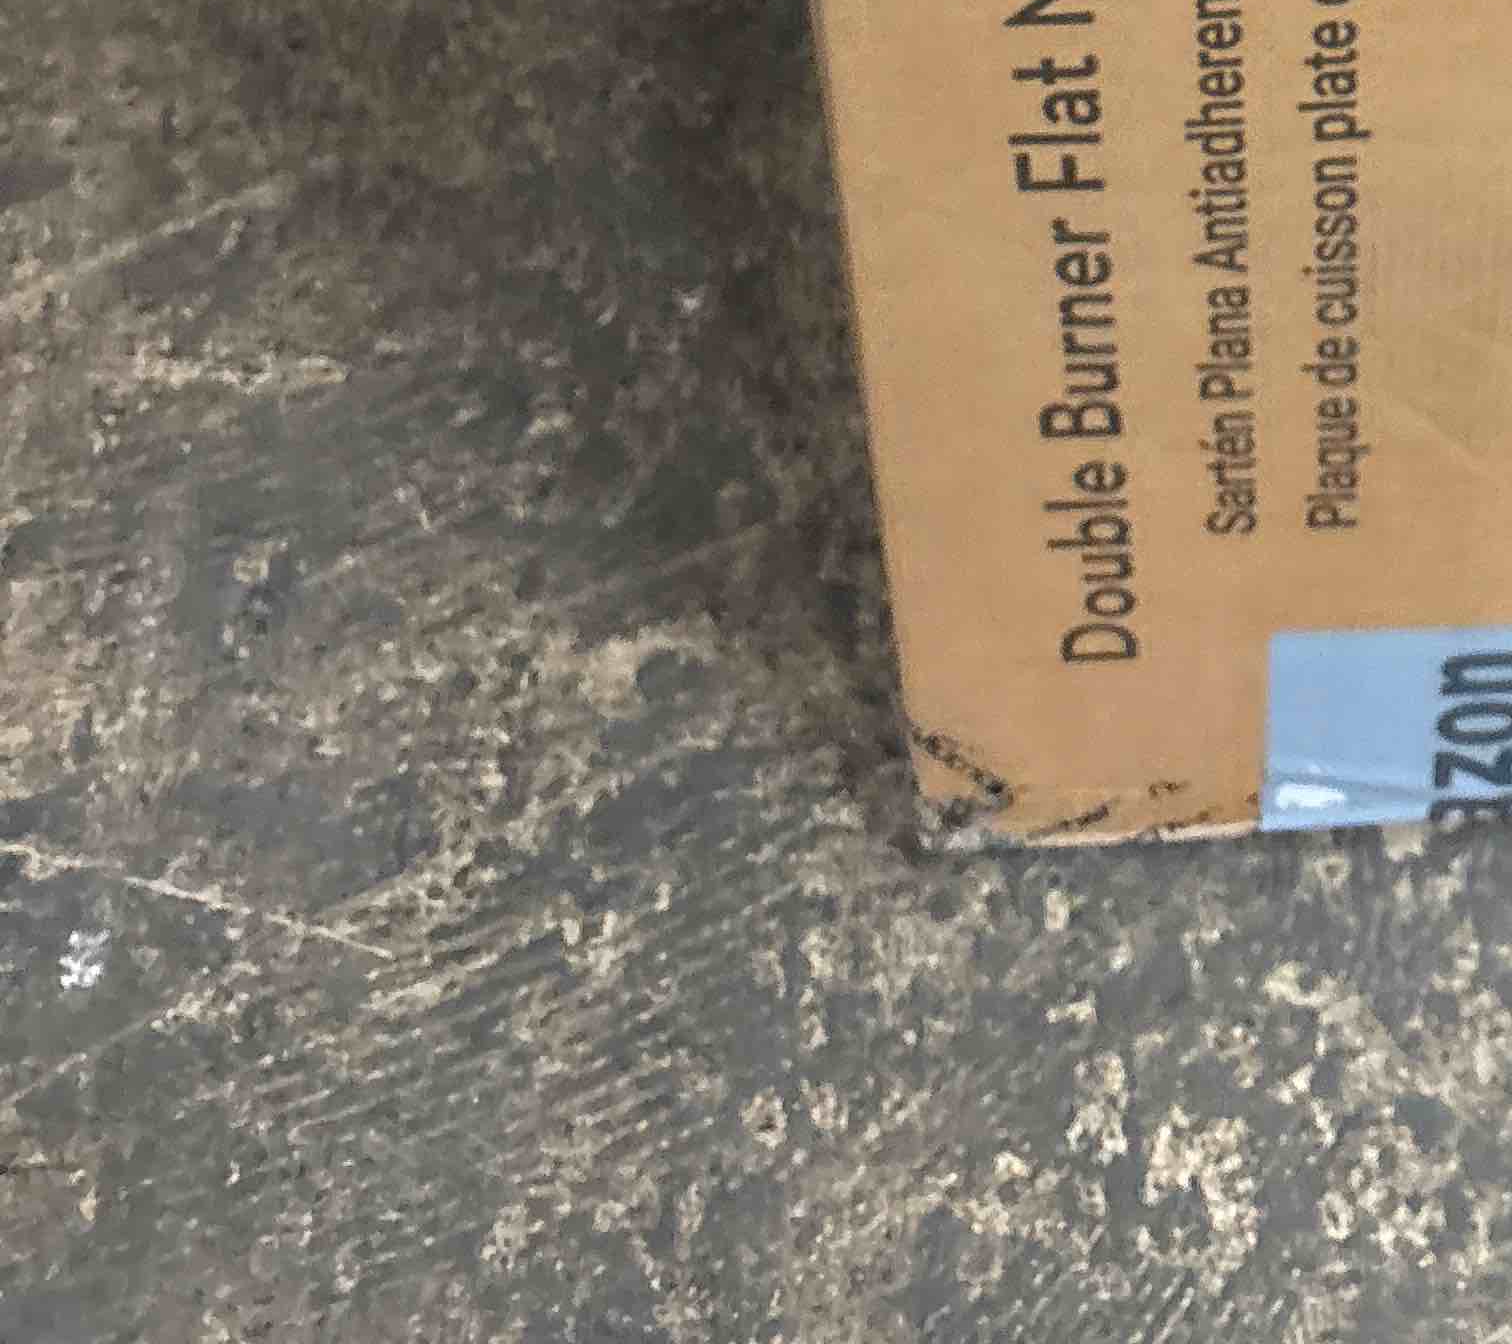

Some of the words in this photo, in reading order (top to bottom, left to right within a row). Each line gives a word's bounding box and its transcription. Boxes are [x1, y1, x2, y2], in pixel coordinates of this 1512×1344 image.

[1007, 54, 1106, 193] Flat
[1297, 20, 1373, 143] plate
[1304, 156, 1359, 327] cuisson
[1038, 216, 1124, 439] Burner
[1195, 285, 1252, 401] Plana
[1303, 335, 1359, 388] de
[1203, 410, 1258, 535] Sartén
[1306, 397, 1369, 530] Plaque
[1043, 460, 1139, 663] Double
